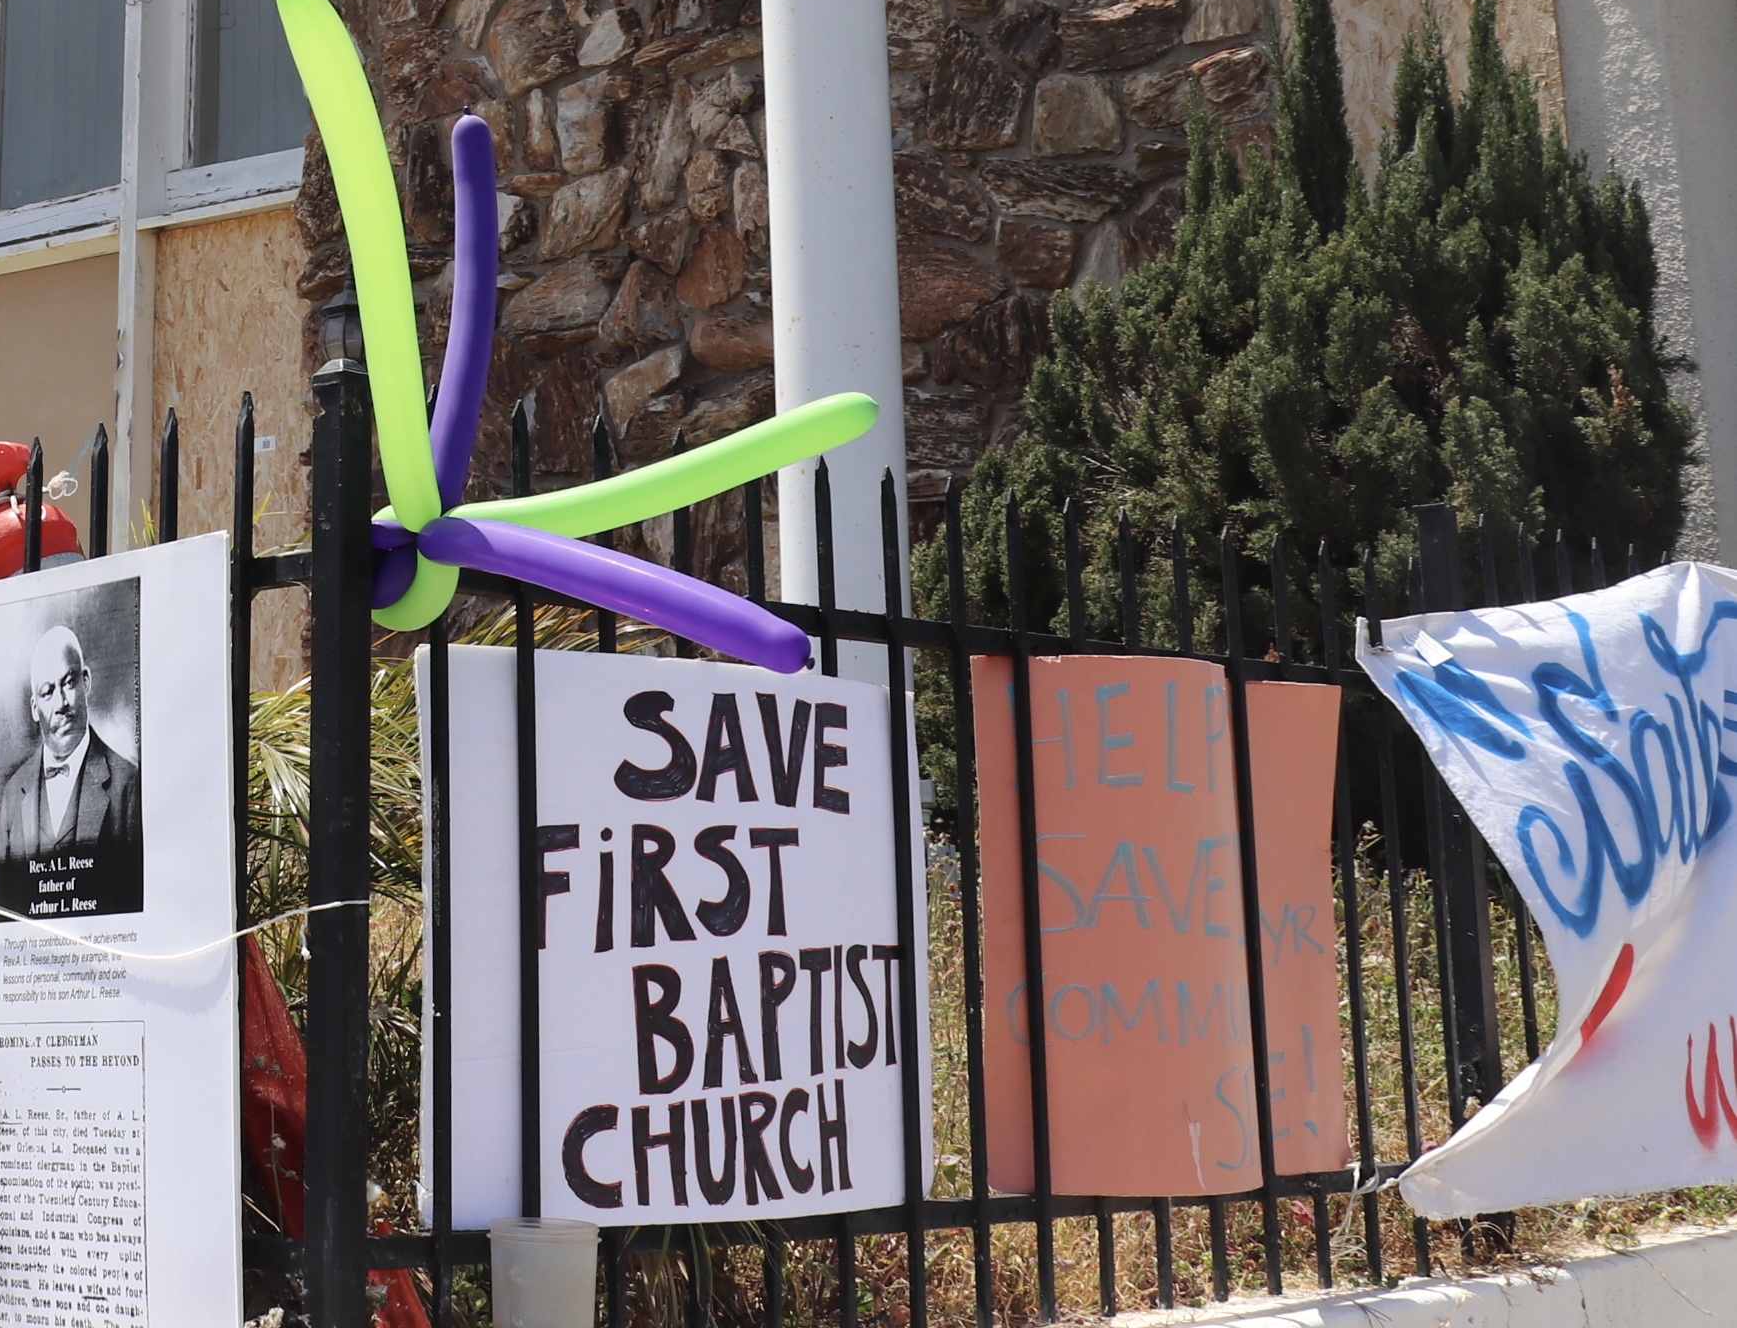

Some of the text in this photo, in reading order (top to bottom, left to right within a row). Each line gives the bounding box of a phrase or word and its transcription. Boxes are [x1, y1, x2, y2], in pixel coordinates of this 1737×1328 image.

[1006, 680, 1230, 794] HELP
[614, 690, 850, 814] SAVE
[29, 855, 93, 873] Rev. A L. Reese
[39, 877, 75, 892] father of
[1037, 834, 1232, 938] SAVE
[28, 896, 96, 914] Arthur L. Reese
[3, 937, 27, 950] Through
[28, 936, 37, 949] his
[93, 930, 137, 944] achievements
[23, 954, 27, 965] L.
[72, 952, 79, 965] by
[3, 967, 126, 984] lessons of personal, community and civic
[40, 990, 45, 1000] to
[47, 988, 56, 1000] his
[91, 987, 96, 998] L.
[99, 986, 121, 998] Reese.
[632, 944, 900, 1095] BAPTIST
[46, 1034, 97, 1047] CLERGYMAN
[30, 1055, 139, 1067] PASSES TO THE BEYOND
[3, 1109, 139, 1120] A. L. Reese, Sr., father of A. L.
[22, 1126, 29, 1136] of
[34, 1126, 47, 1135] this
[53, 1127, 67, 1137] city,
[72, 1126, 87, 1137] died
[93, 1126, 125, 1139] Tuesday
[132, 1129, 139, 1138] at
[51, 1143, 62, 1153] La.
[72, 1143, 106, 1155] Deceased
[113, 1146, 129, 1154] was
[136, 1147, 140, 1155] a
[562, 1078, 852, 1208] CHURCH
[37, 1159, 74, 1172] clergyman
[80, 1161, 86, 1171] in
[92, 1161, 104, 1171] the
[111, 1160, 140, 1174] Baptist
[46, 1177, 53, 1187] of
[57, 1178, 67, 1188] the
[71, 1176, 93, 1191] south;
[98, 1181, 113, 1189] was
[117, 1180, 140, 1191] presi-
[13, 1193, 20, 1203] of
[24, 1193, 35, 1203] the
[38, 1193, 75, 1206] Twentieth
[78, 1194, 108, 1208] Century
[113, 1196, 140, 1208] Educa-
[20, 1209, 32, 1220] and
[42, 1210, 77, 1223] Industrial
[87, 1212, 123, 1226] Congress
[133, 1215, 140, 1226] of
[34, 1228, 47, 1239] and
[51, 1231, 55, 1239] a
[59, 1231, 73, 1240] man
[78, 1230, 93, 1241] who
[96, 1231, 109, 1242] has
[113, 1232, 141, 1245] always
[17, 1244, 50, 1255] identified
[61, 1247, 76, 1257] with
[87, 1250, 108, 1261] every
[119, 1250, 141, 1263] uplift
[53, 1263, 64, 1274] the
[70, 1264, 96, 1277] colored
[134, 1269, 142, 1280] of
[10, 1278, 30, 1289] south.
[38, 1279, 48, 1290] He
[52, 1280, 74, 1292] leaves
[78, 1285, 82, 1293] a
[87, 1283, 102, 1295] wife
[106, 1284, 120, 1295] and
[125, 1286, 142, 1298] four
[31, 1296, 50, 1308] three
[56, 1300, 71, 1310] sons
[77, 1300, 90, 1312] and
[96, 1306, 109, 1314] one
[115, 1303, 143, 1317] daugh-
[14, 1312, 21, 1322] to
[26, 1314, 48, 1325] mourn
[54, 1315, 65, 1326] his
[71, 1317, 94, 1328] death.
